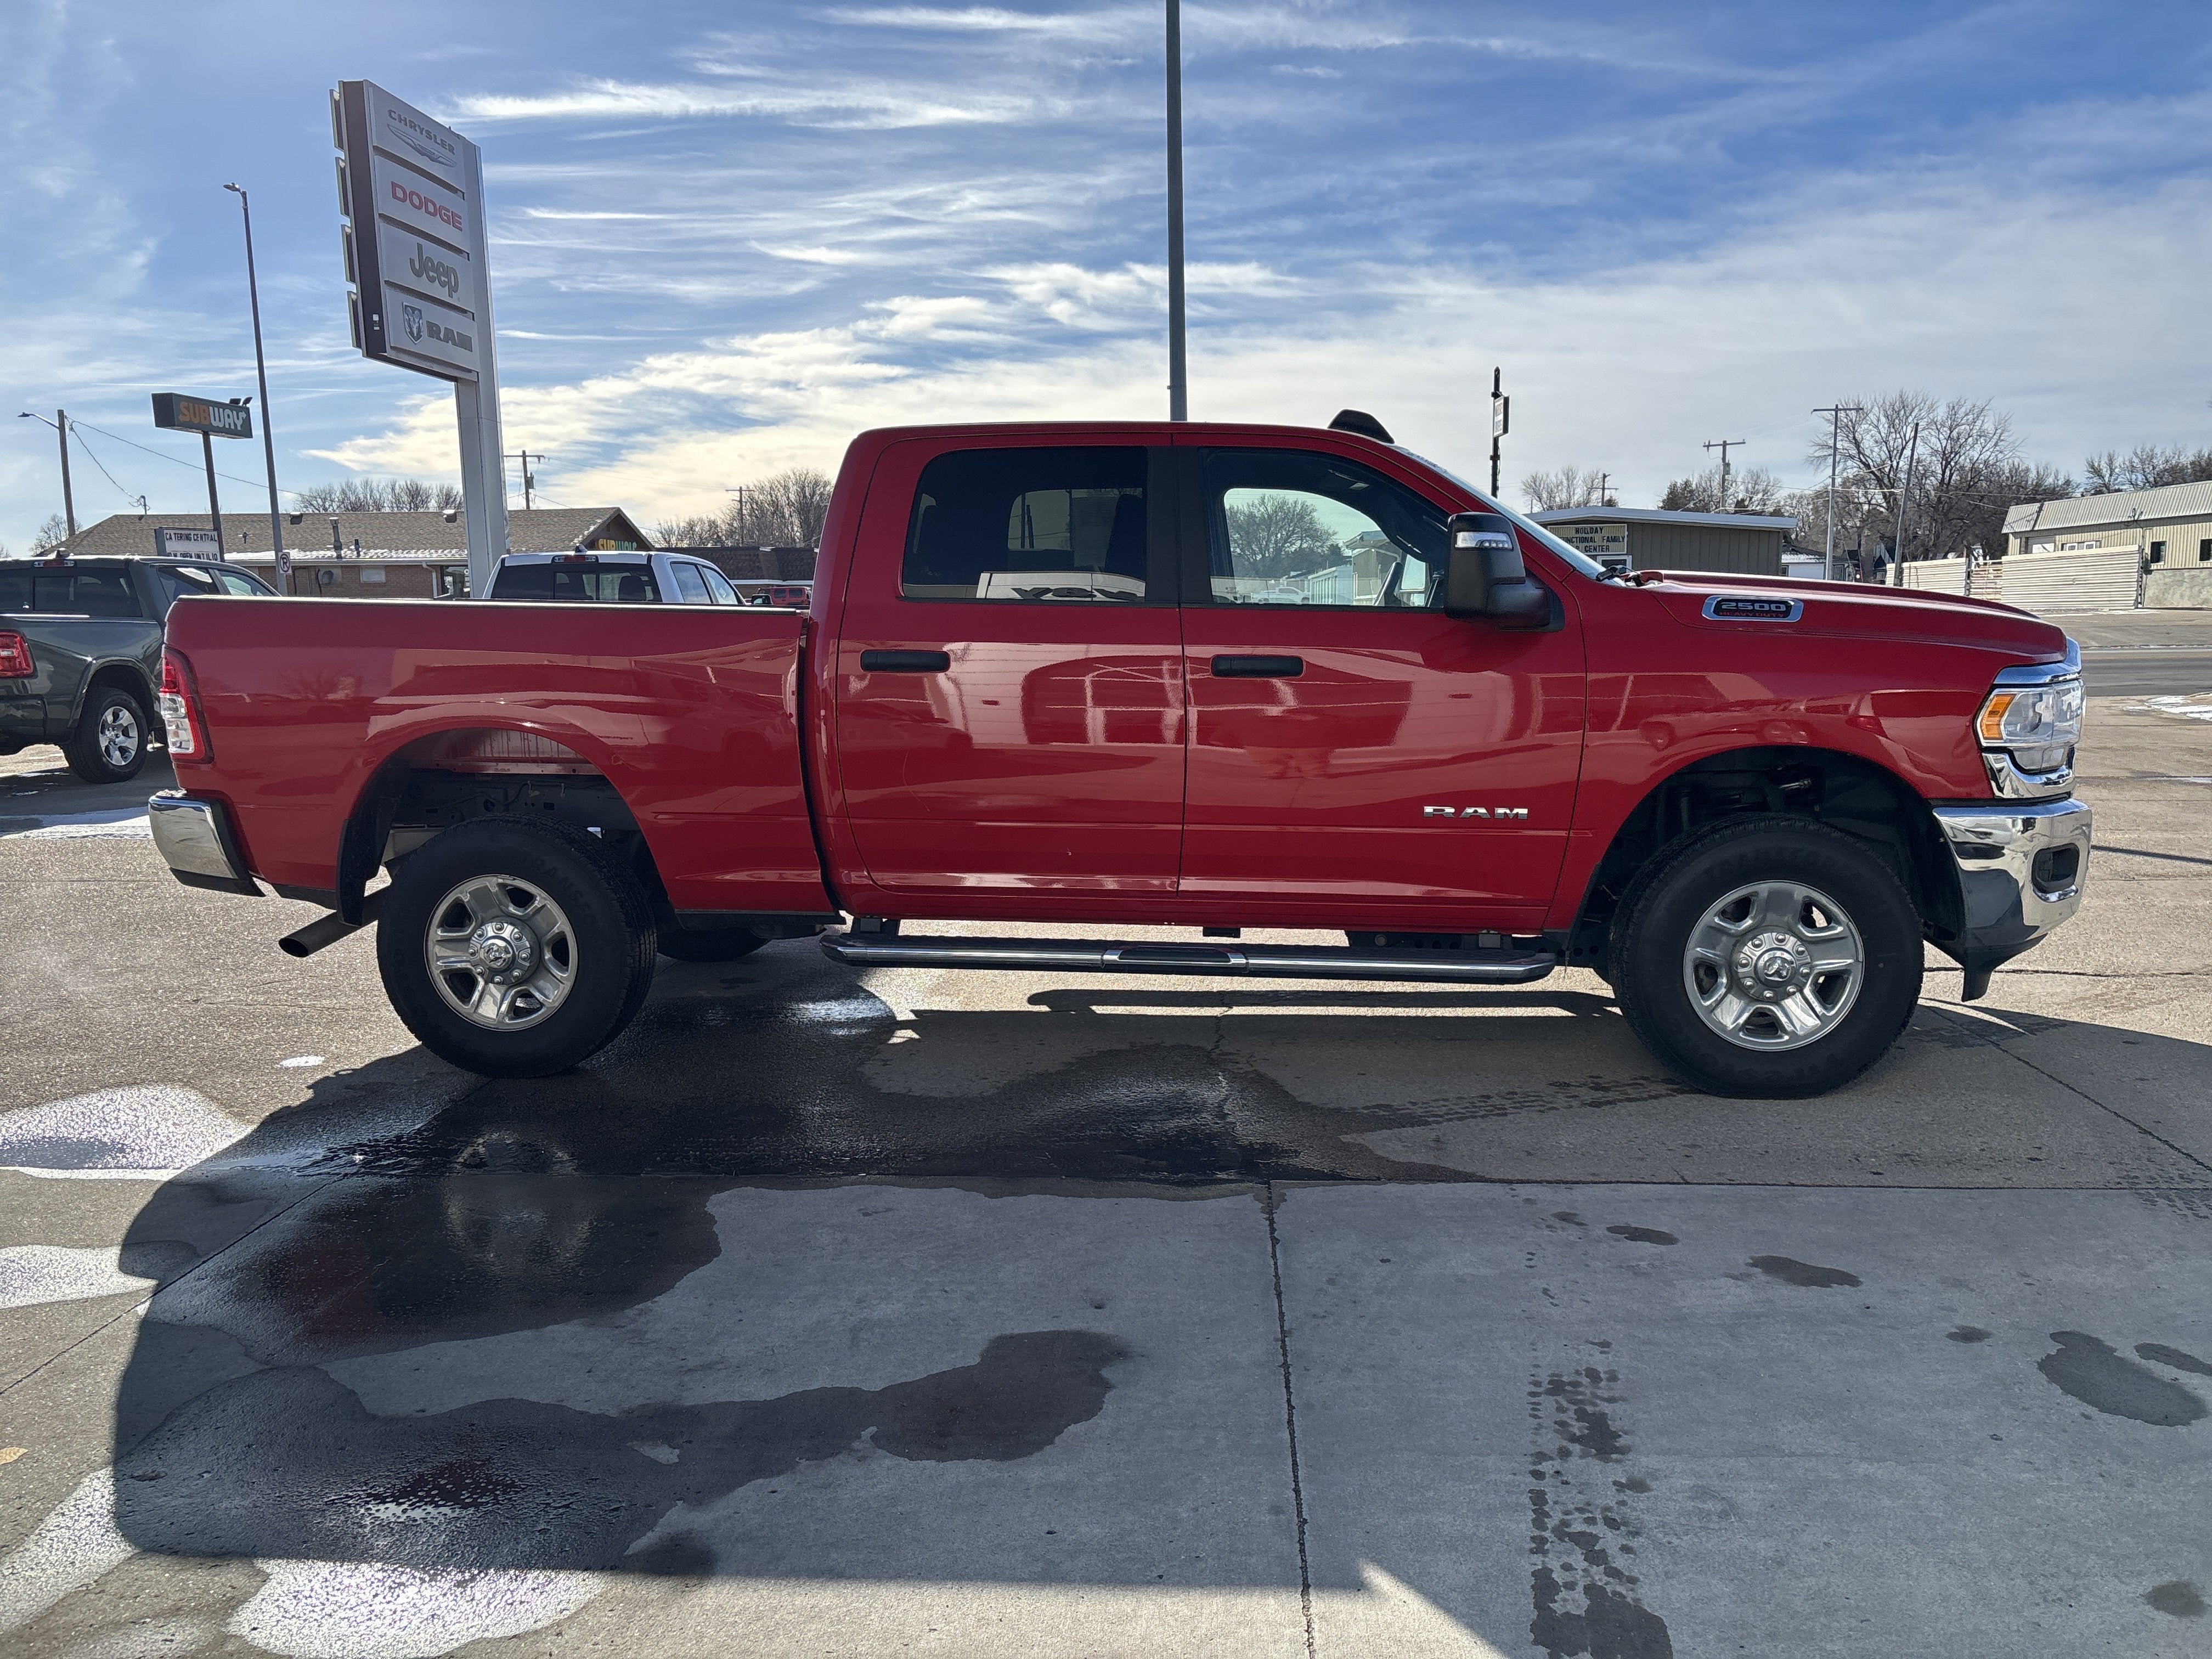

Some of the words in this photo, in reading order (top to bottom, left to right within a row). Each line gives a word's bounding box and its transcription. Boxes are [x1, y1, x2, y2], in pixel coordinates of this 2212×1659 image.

[387, 109, 455, 156] CHRYSLER
[391, 181, 463, 232] DODGE
[409, 242, 459, 298] Jeep
[426, 320, 473, 353] RAM
[178, 401, 247, 431] SUBWAY
[193, 533, 217, 542] CENTRAL
[1722, 602, 1786, 611] 2500
[1424, 806, 1528, 819] RAM
